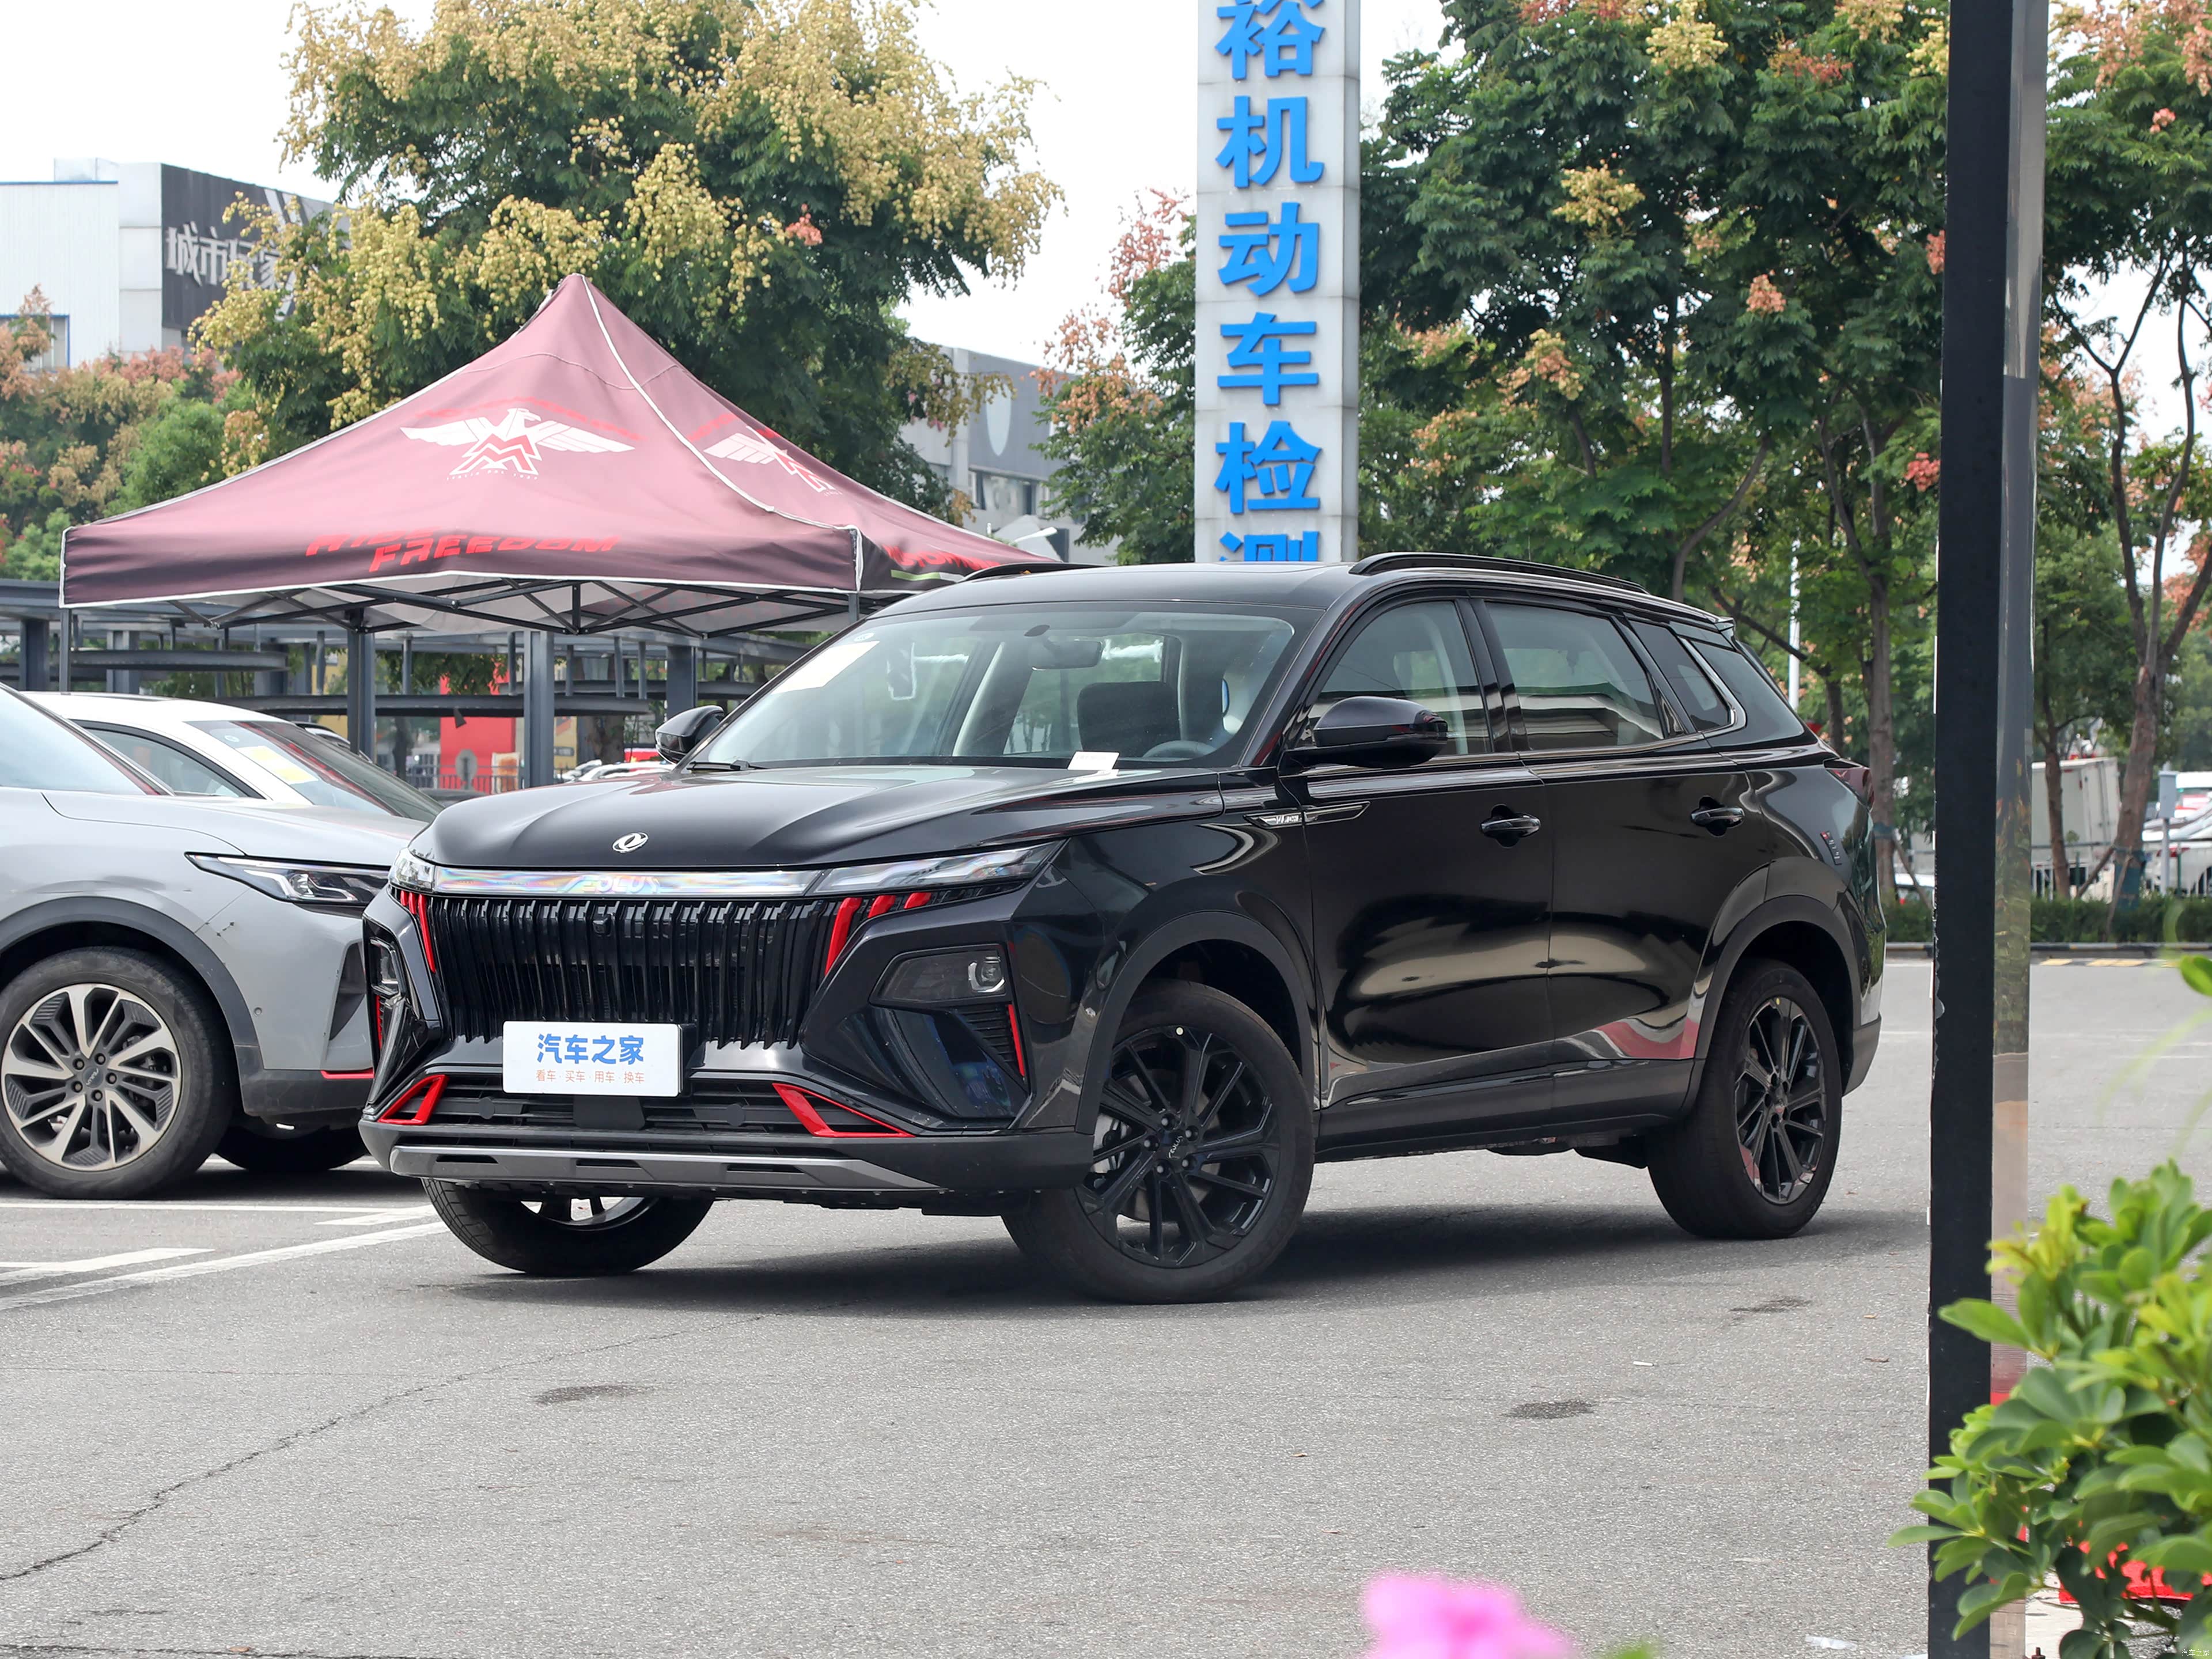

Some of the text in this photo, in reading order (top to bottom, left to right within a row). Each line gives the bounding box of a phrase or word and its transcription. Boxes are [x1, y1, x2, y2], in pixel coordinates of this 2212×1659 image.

[368, 535, 620, 573] FREEDOM
[536, 1033, 644, 1065] 汽车之家
